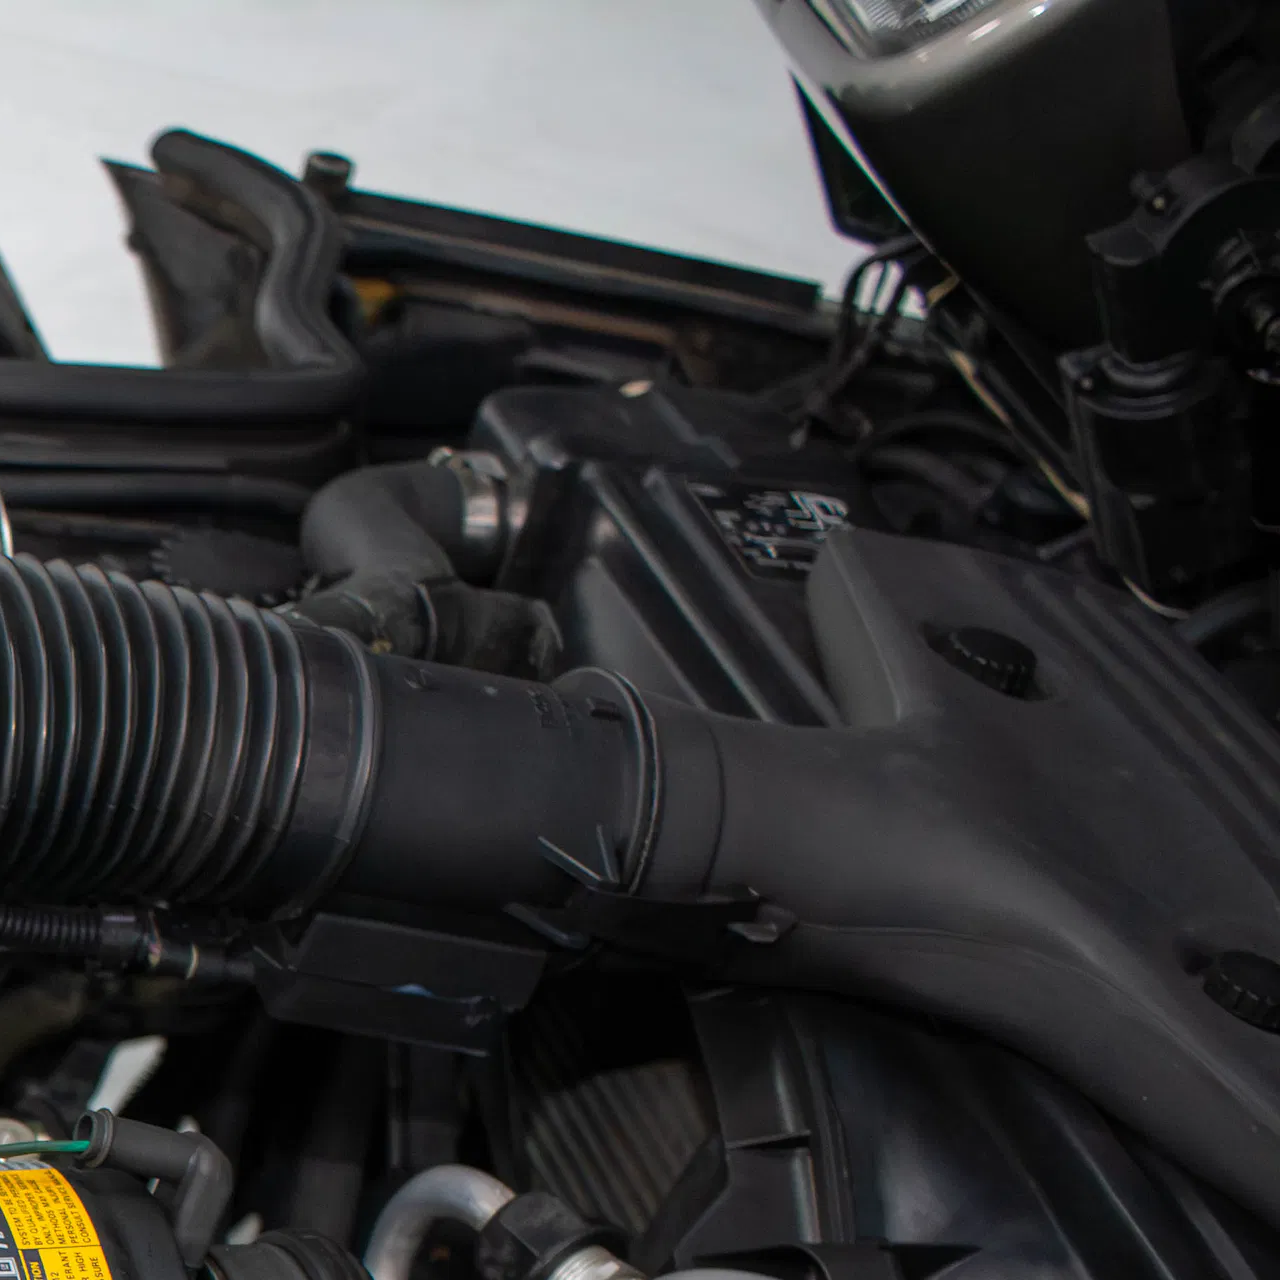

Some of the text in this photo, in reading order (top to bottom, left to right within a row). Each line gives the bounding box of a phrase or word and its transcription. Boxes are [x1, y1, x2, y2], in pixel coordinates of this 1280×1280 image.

[13, 1217, 31, 1246] SYSTEM
[33, 1237, 43, 1246] BY
[45, 1210, 66, 1245] METHODS
[60, 1208, 79, 1244] PERSONAL
[71, 1210, 91, 1244] CONSULT
[74, 1252, 89, 1272] HIGH
